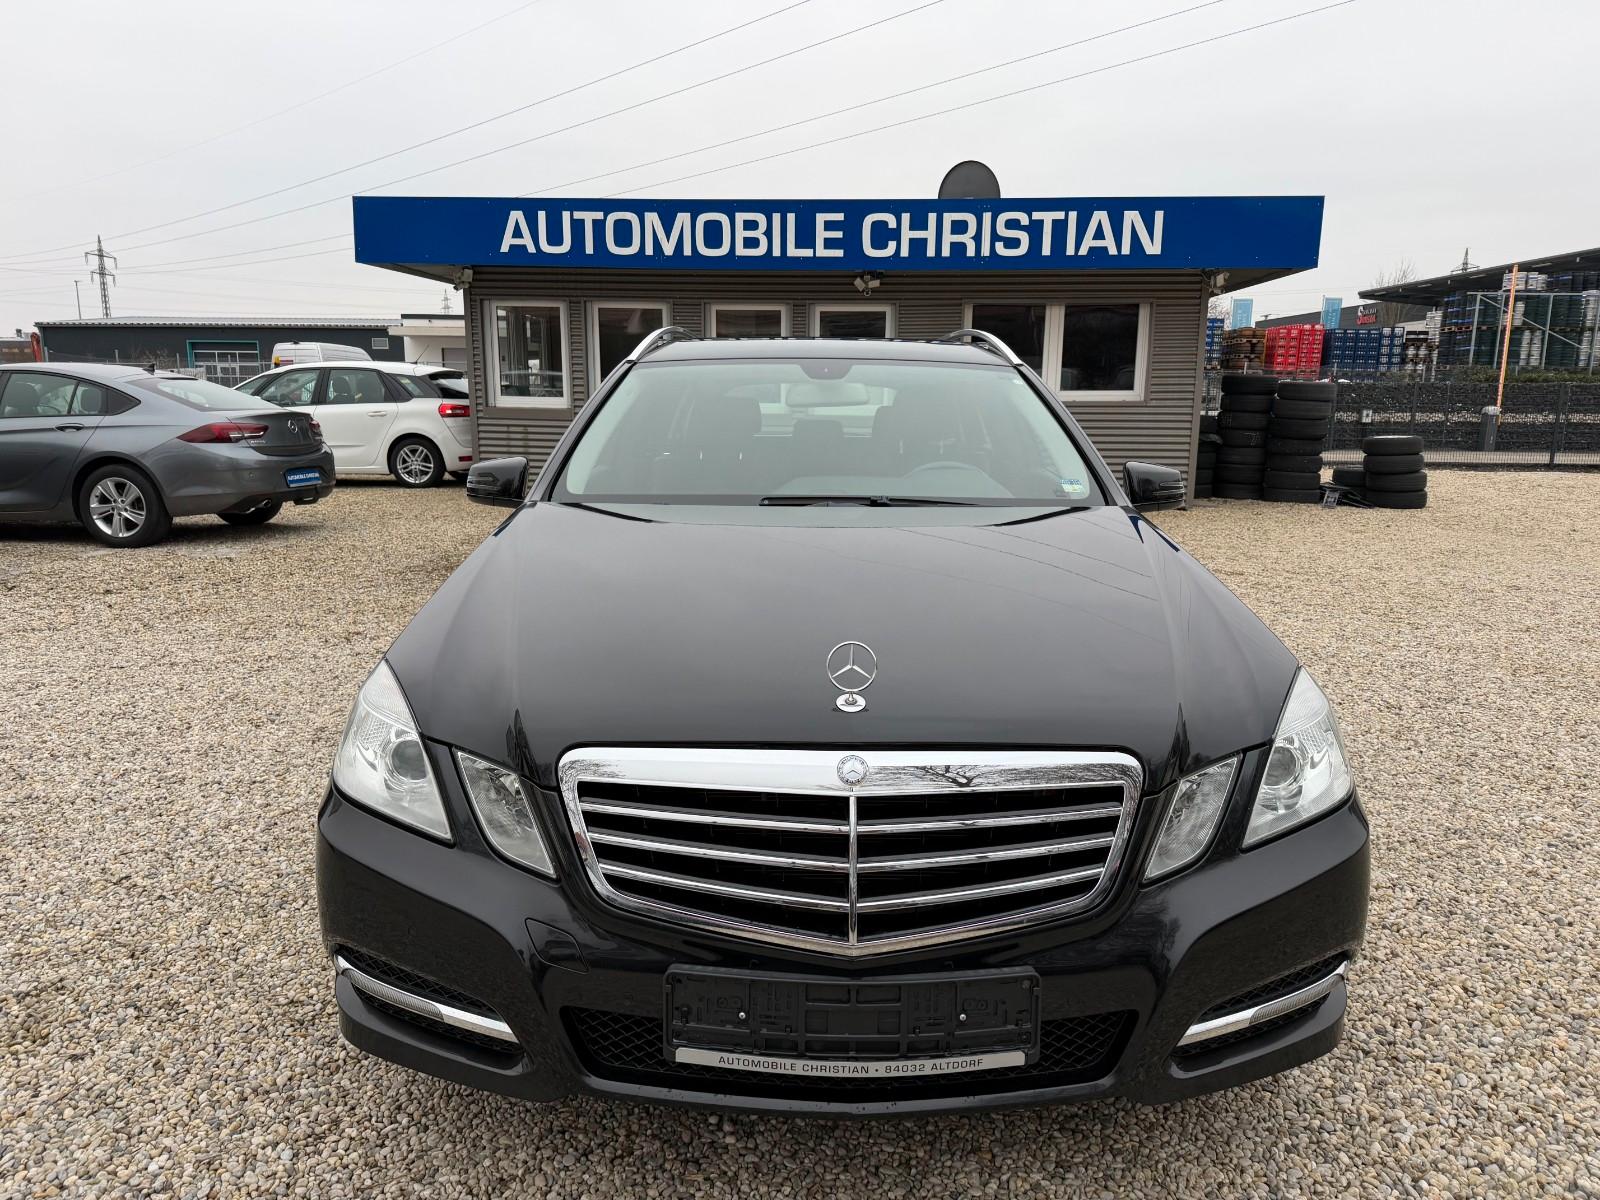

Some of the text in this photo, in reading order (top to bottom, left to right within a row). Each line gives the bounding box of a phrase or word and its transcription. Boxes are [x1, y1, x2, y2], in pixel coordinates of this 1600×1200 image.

[499, 210, 1165, 258] AUTOMOBILE CHRISTIAN
[718, 1055, 984, 1074] AUTOMOBILE CHRISTIAN 84032 ALTDORF
